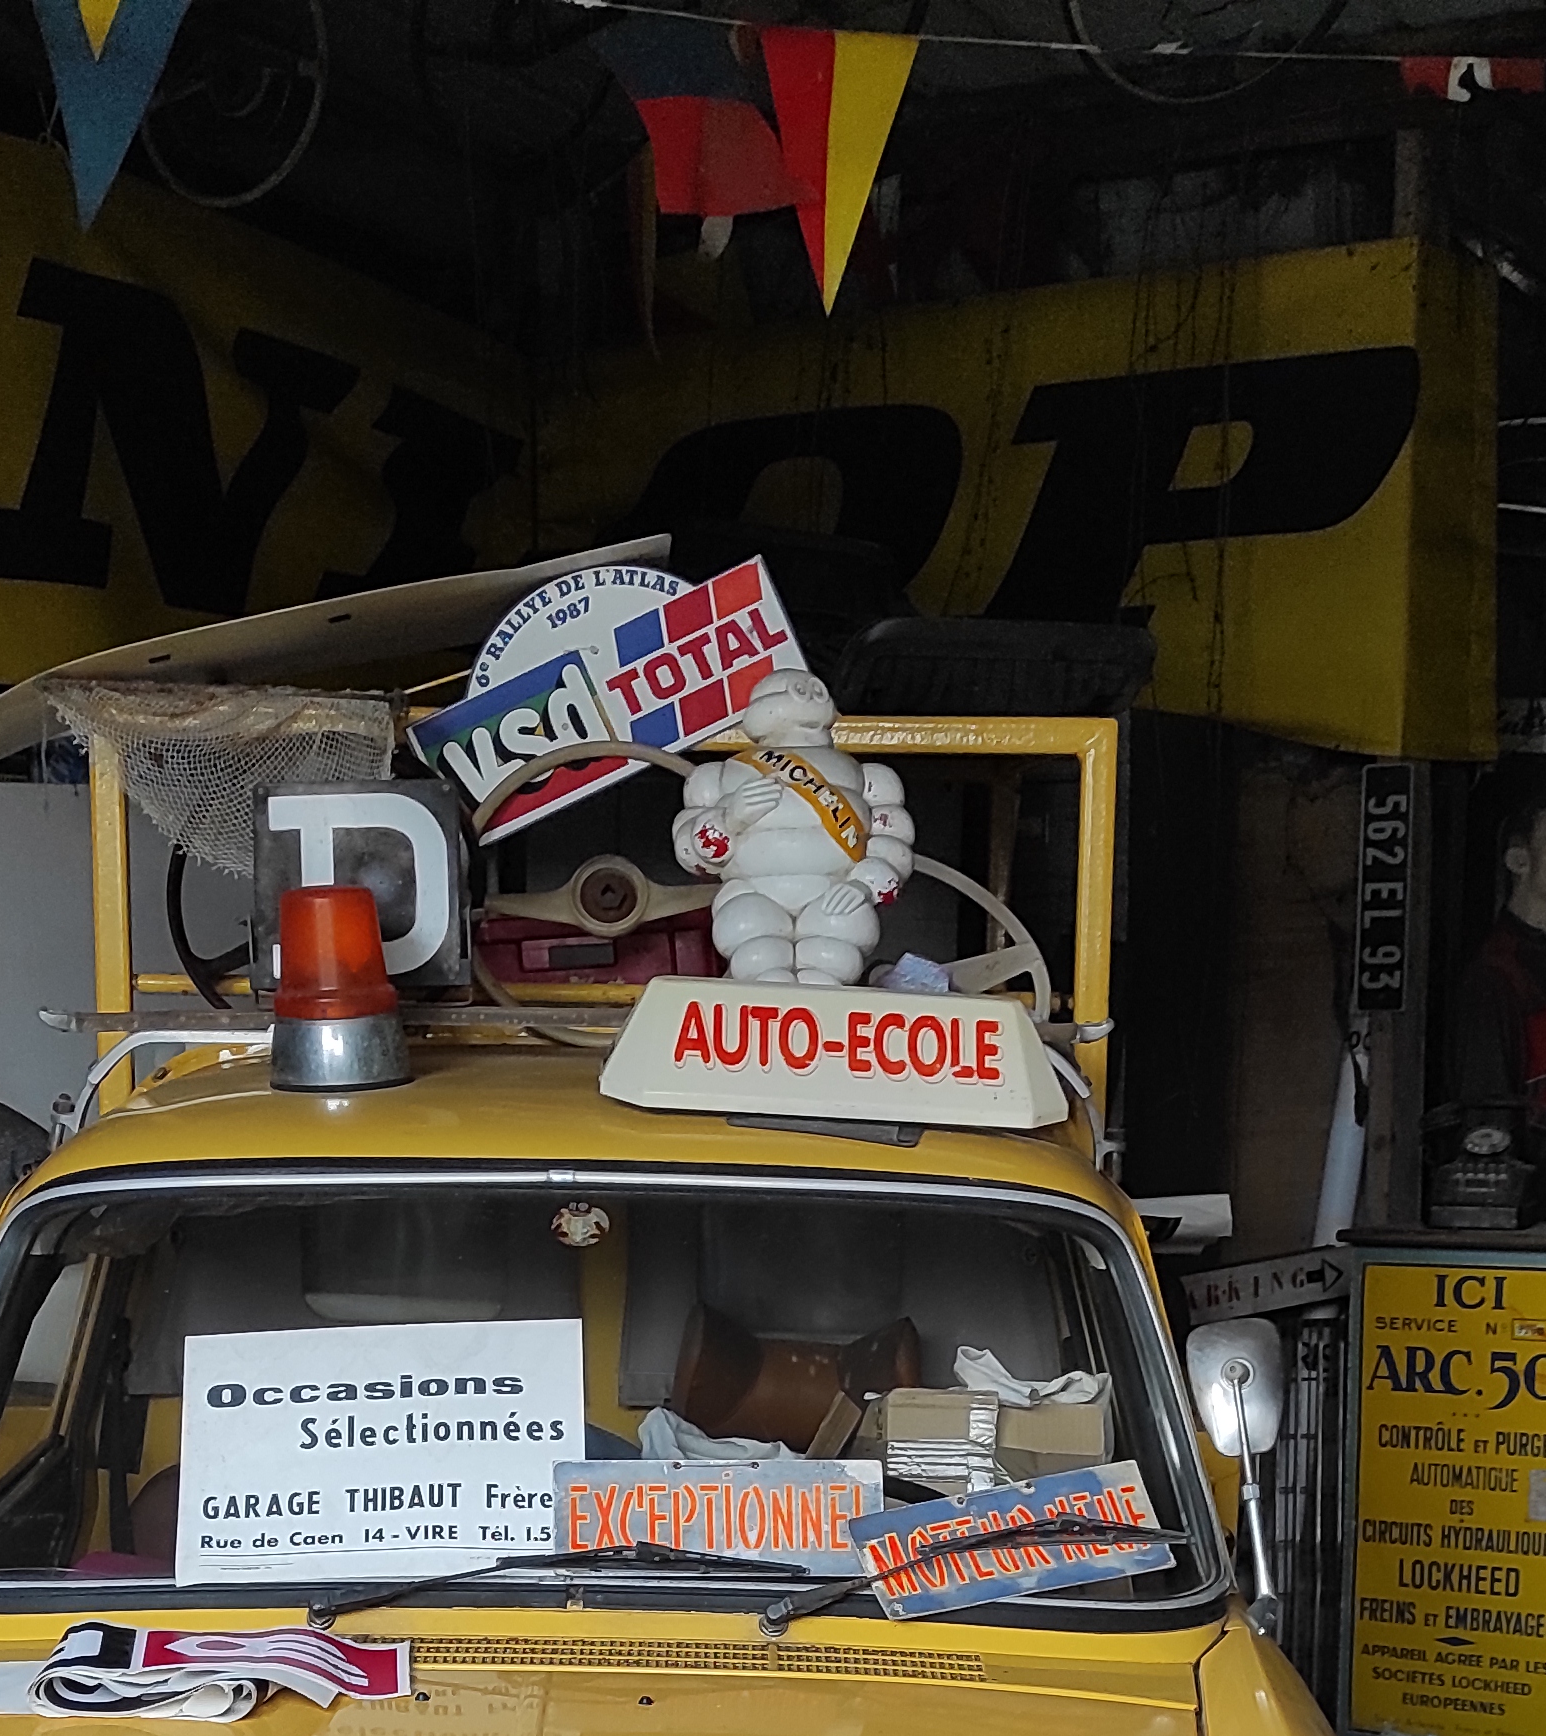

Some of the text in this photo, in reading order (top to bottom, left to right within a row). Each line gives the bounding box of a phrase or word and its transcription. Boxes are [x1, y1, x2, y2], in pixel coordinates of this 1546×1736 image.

[486, 590, 553, 661] RALLYE
[557, 574, 585, 599] DE
[593, 569, 680, 596] L'ATLAS
[547, 595, 591, 629] 1987
[606, 607, 788, 716] TOTAL
[758, 747, 859, 850] MICHELIN
[1359, 793, 1407, 989] 562 EL 93
[674, 1000, 1005, 1082] AUTO-ECOLE
[1434, 1274, 1507, 1310] ICI
[1375, 1316, 1458, 1333] SERVICE
[206, 1374, 525, 1409] Occasions
[299, 1411, 565, 1450] Sélectionnées
[1378, 1421, 1466, 1454] CONTRÔLE
[1409, 1462, 1519, 1493] AUTOMATIQUE
[203, 1490, 321, 1520] GARAGE
[345, 1483, 462, 1513] THIBAUT
[1449, 1498, 1475, 1517] DES
[201, 1535, 243, 1549] Rue
[252, 1533, 279, 1548] de
[289, 1531, 344, 1547] Caen
[479, 1525, 515, 1542] Tél.
[1362, 1518, 1433, 1548] CIRCUITS
[1397, 1558, 1520, 1598] LOCKHEED
[1359, 1597, 1416, 1627] FREINS
[1360, 1643, 1429, 1664] APPAREIL
[1488, 1655, 1520, 1673] PAR
[1451, 1674, 1533, 1697] LOCKHEED
